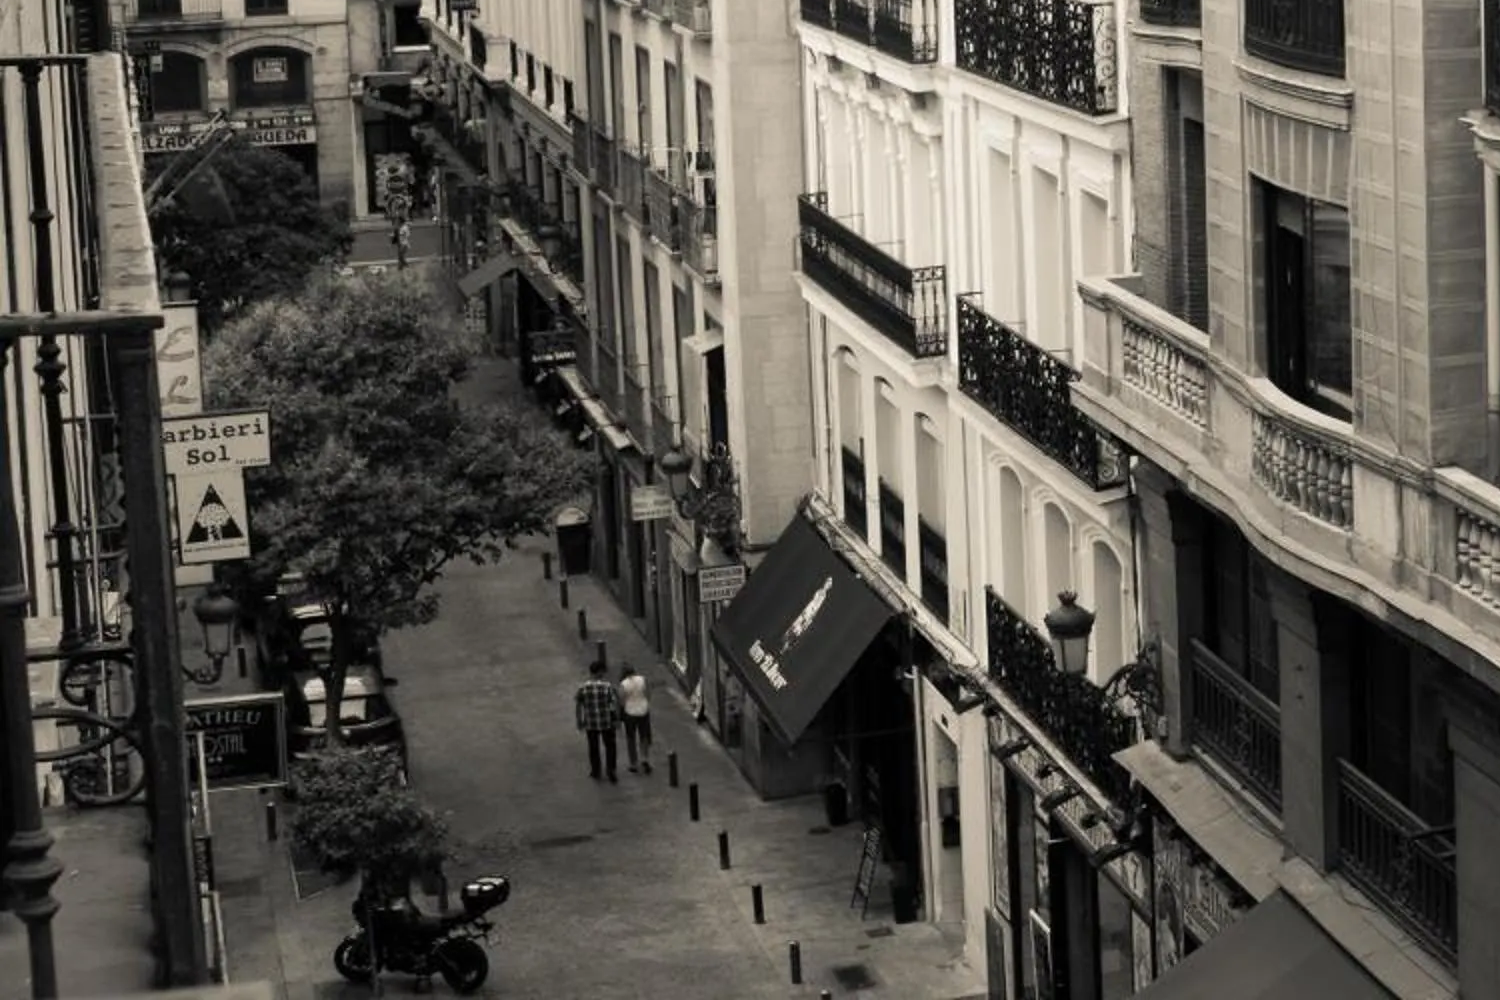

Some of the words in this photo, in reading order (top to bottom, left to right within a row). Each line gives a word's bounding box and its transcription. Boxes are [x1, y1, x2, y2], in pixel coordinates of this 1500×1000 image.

[164, 417, 265, 443] arbieri
[186, 445, 232, 466] Sol
[184, 710, 261, 727] ATHEU
